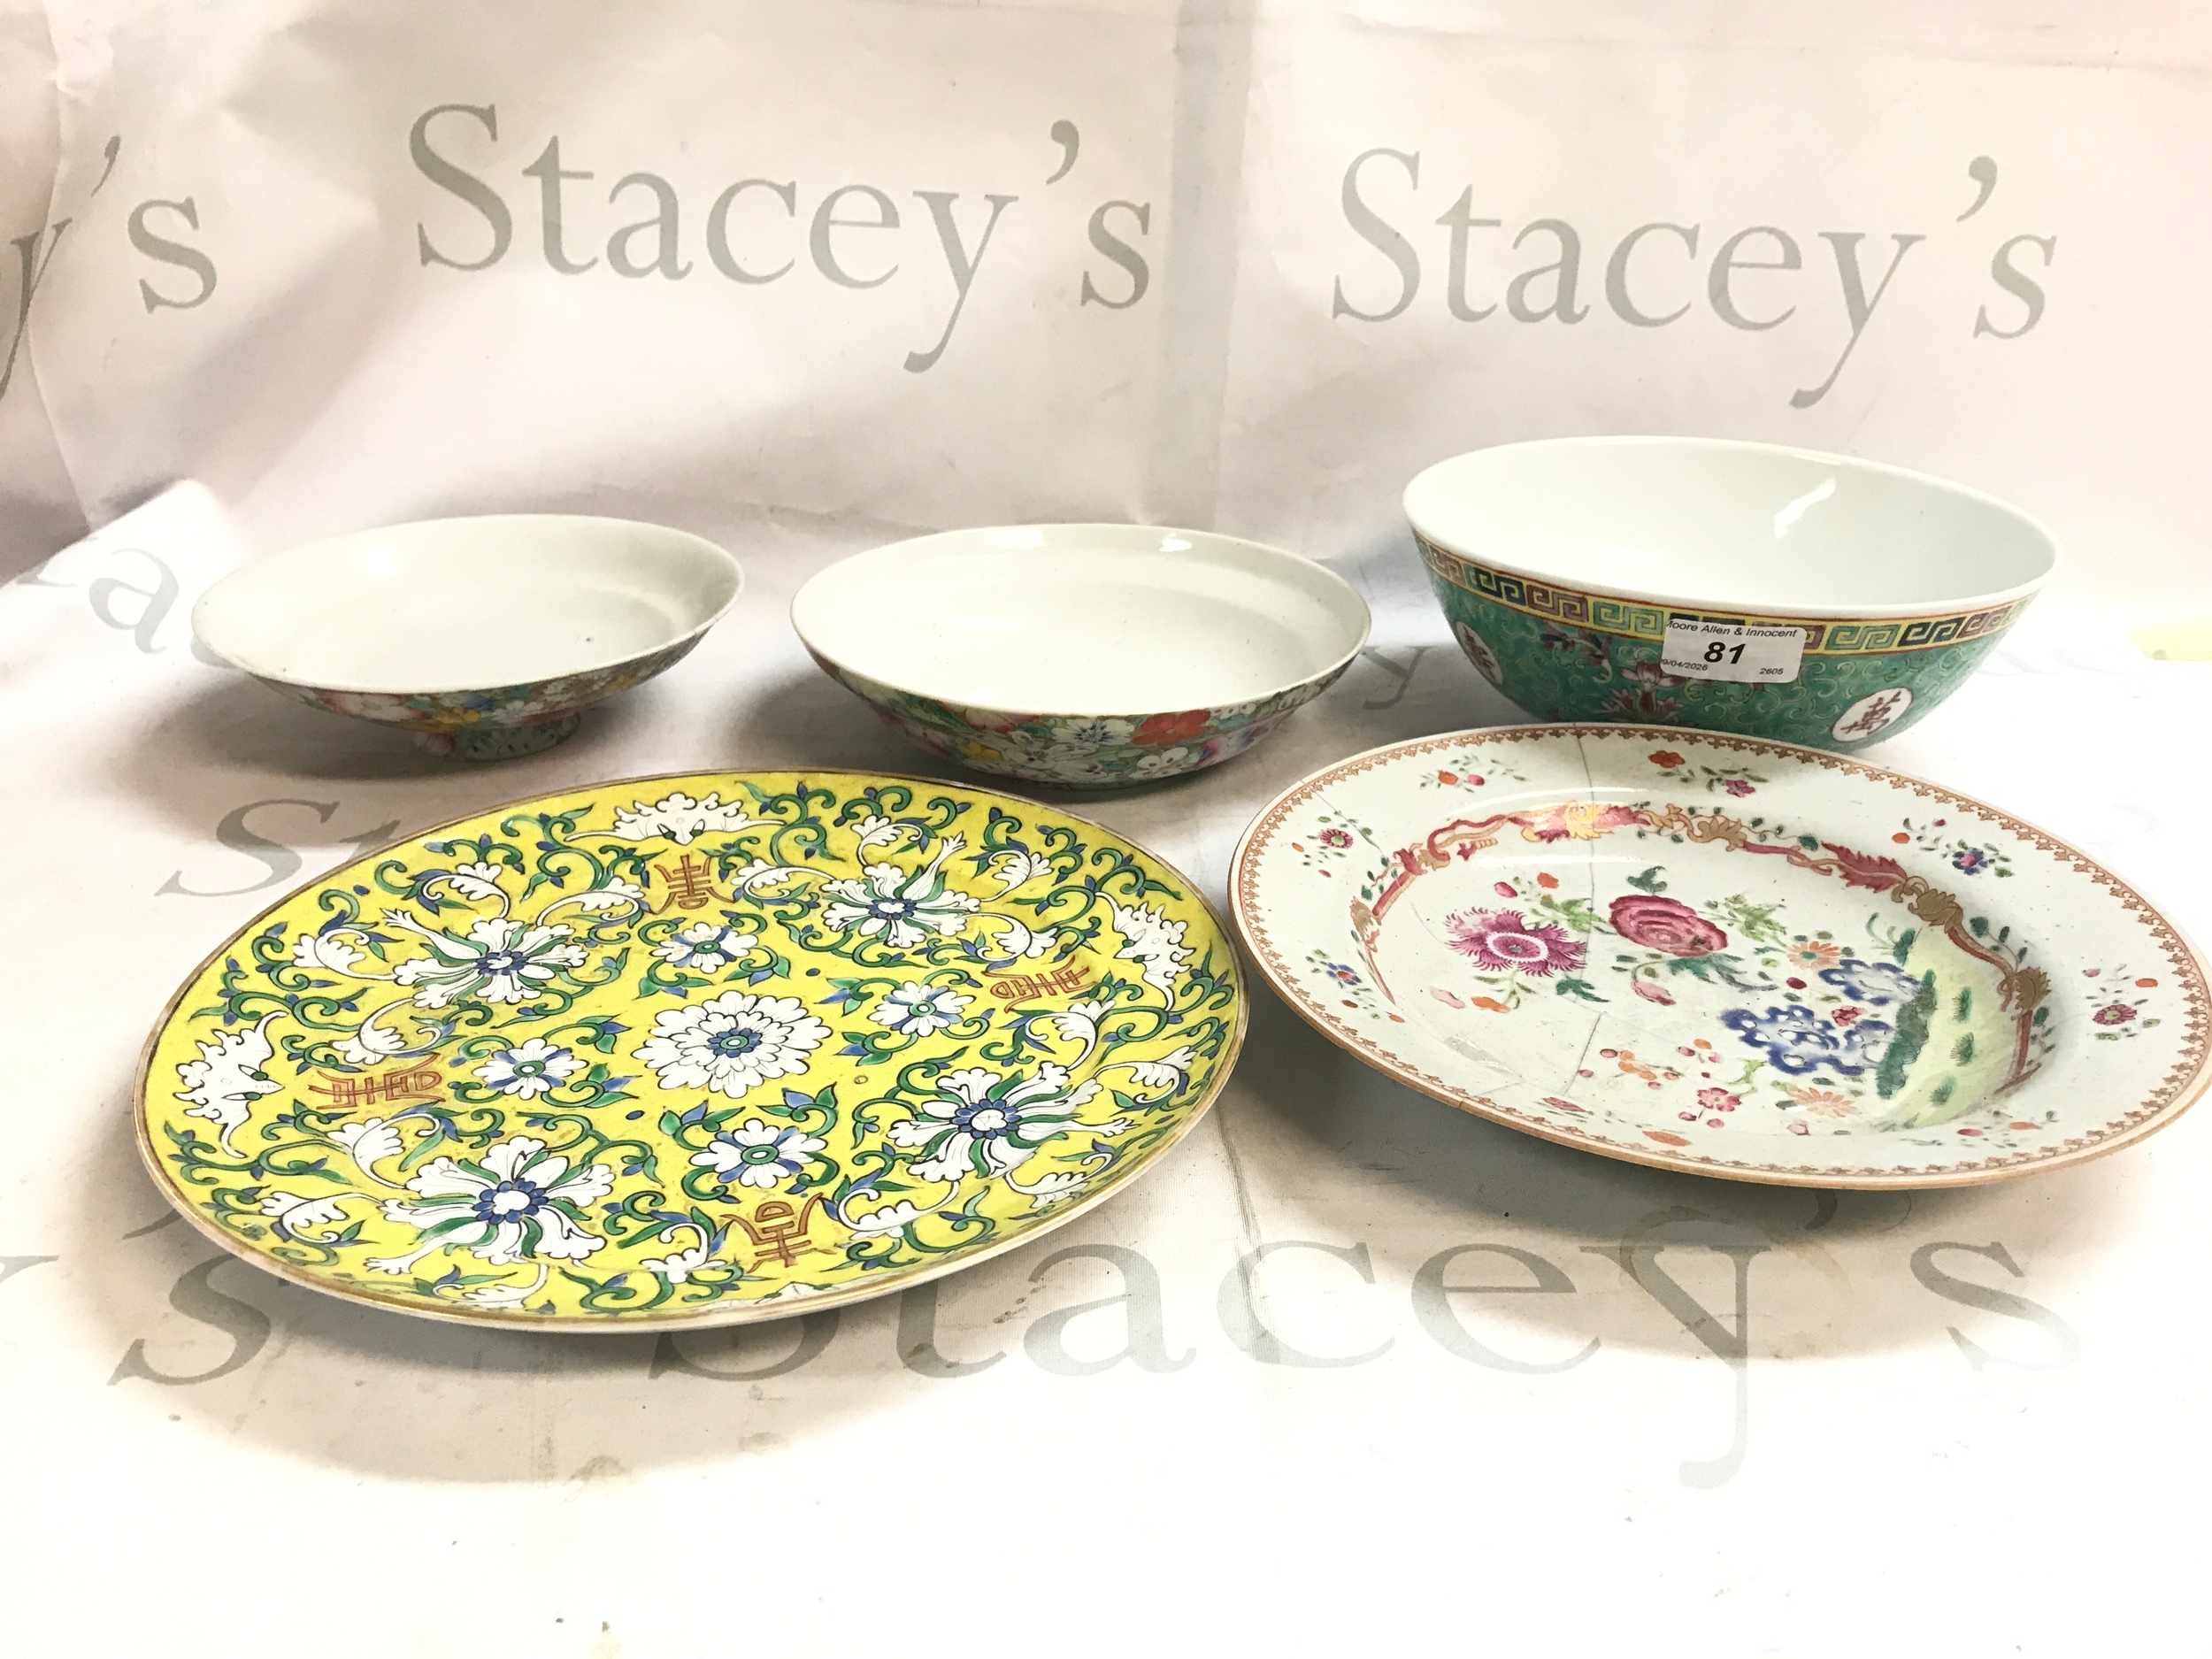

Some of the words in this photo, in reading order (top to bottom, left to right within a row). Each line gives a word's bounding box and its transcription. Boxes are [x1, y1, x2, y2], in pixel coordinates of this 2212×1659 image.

[409, 103, 1151, 373] Stacey's
[1332, 147, 2057, 409] Stacey's
[1701, 625, 1731, 635] Allen
[1733, 626, 1743, 636] &
[1746, 627, 1798, 638] Innocent
[1703, 641, 1746, 664] 81
[1661, 658, 1709, 672] 9/04/2026
